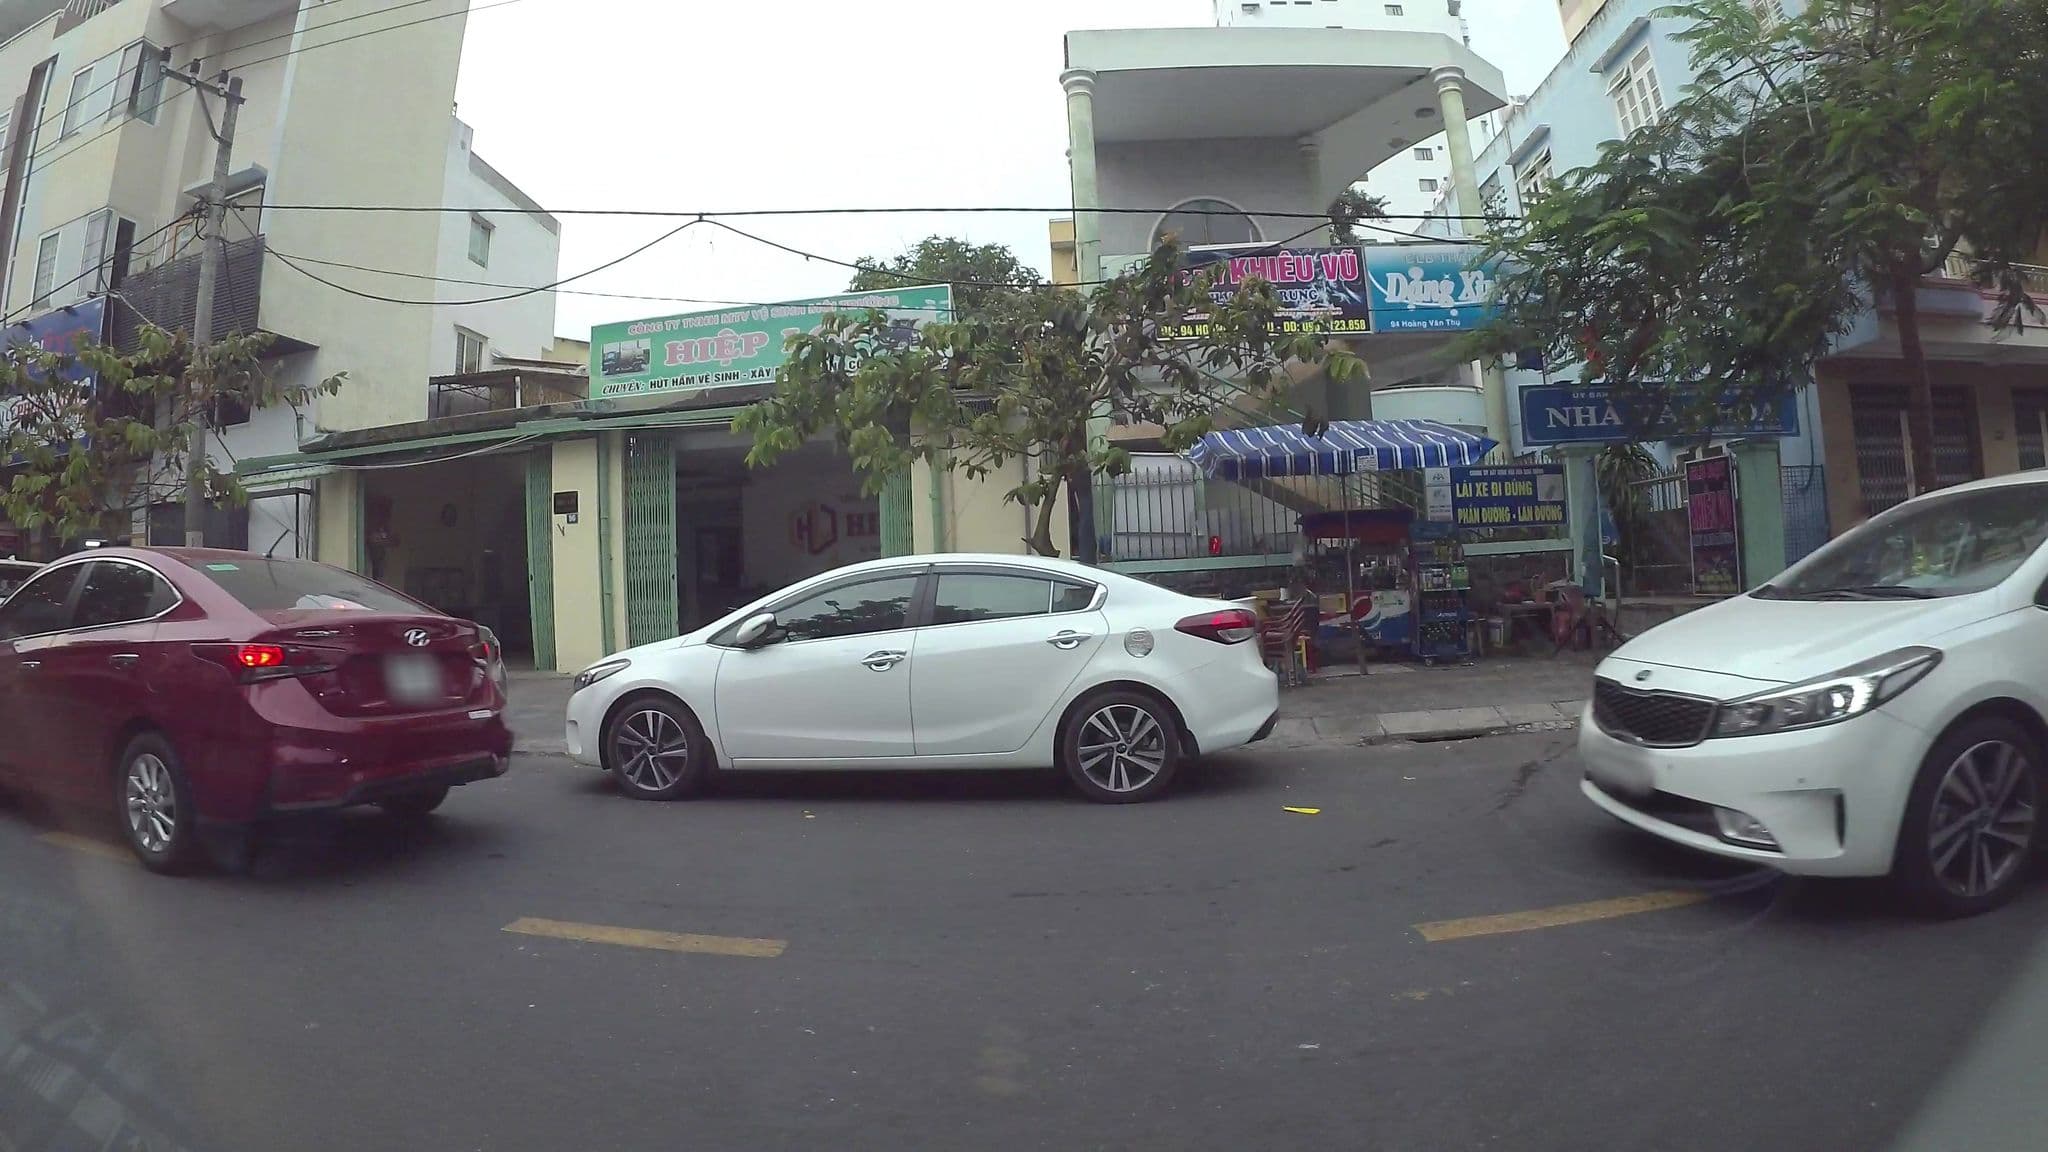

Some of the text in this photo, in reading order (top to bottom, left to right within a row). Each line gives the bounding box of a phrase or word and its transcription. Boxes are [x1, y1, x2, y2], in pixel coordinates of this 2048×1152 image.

[1229, 251, 1313, 285] KHIÊU
[1321, 249, 1359, 282] VŨ
[1280, 289, 1317, 302] RUNG
[665, 319, 681, 330] TY
[664, 328, 769, 366] HIỆP
[649, 375, 669, 390] HÚT
[714, 371, 740, 384] SINH
[751, 365, 771, 379] XÂY
[1546, 399, 1625, 429] NHÀ
[1475, 482, 1489, 496] XE
